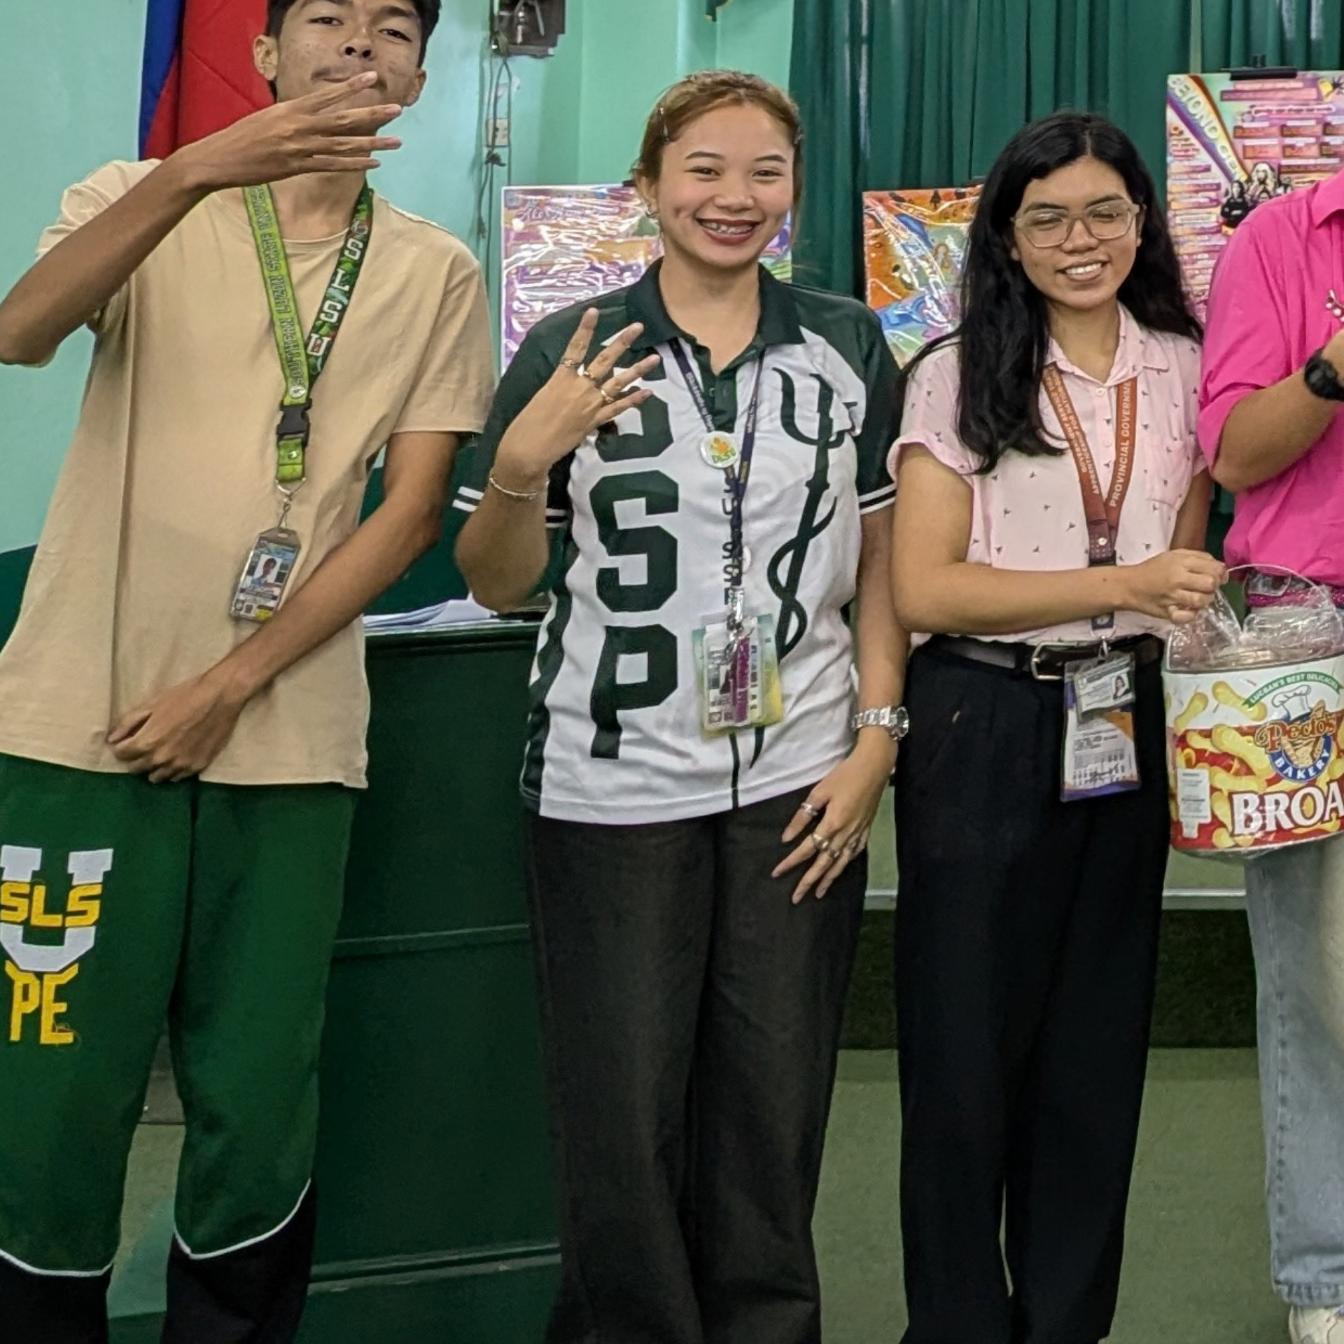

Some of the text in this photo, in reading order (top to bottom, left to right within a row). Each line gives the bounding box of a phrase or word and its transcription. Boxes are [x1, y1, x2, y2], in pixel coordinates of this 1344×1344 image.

[1109, 440, 1129, 508] PROVINCIAL
[1274, 750, 1330, 780] BAKERY
[4, 960, 79, 1045] PE
